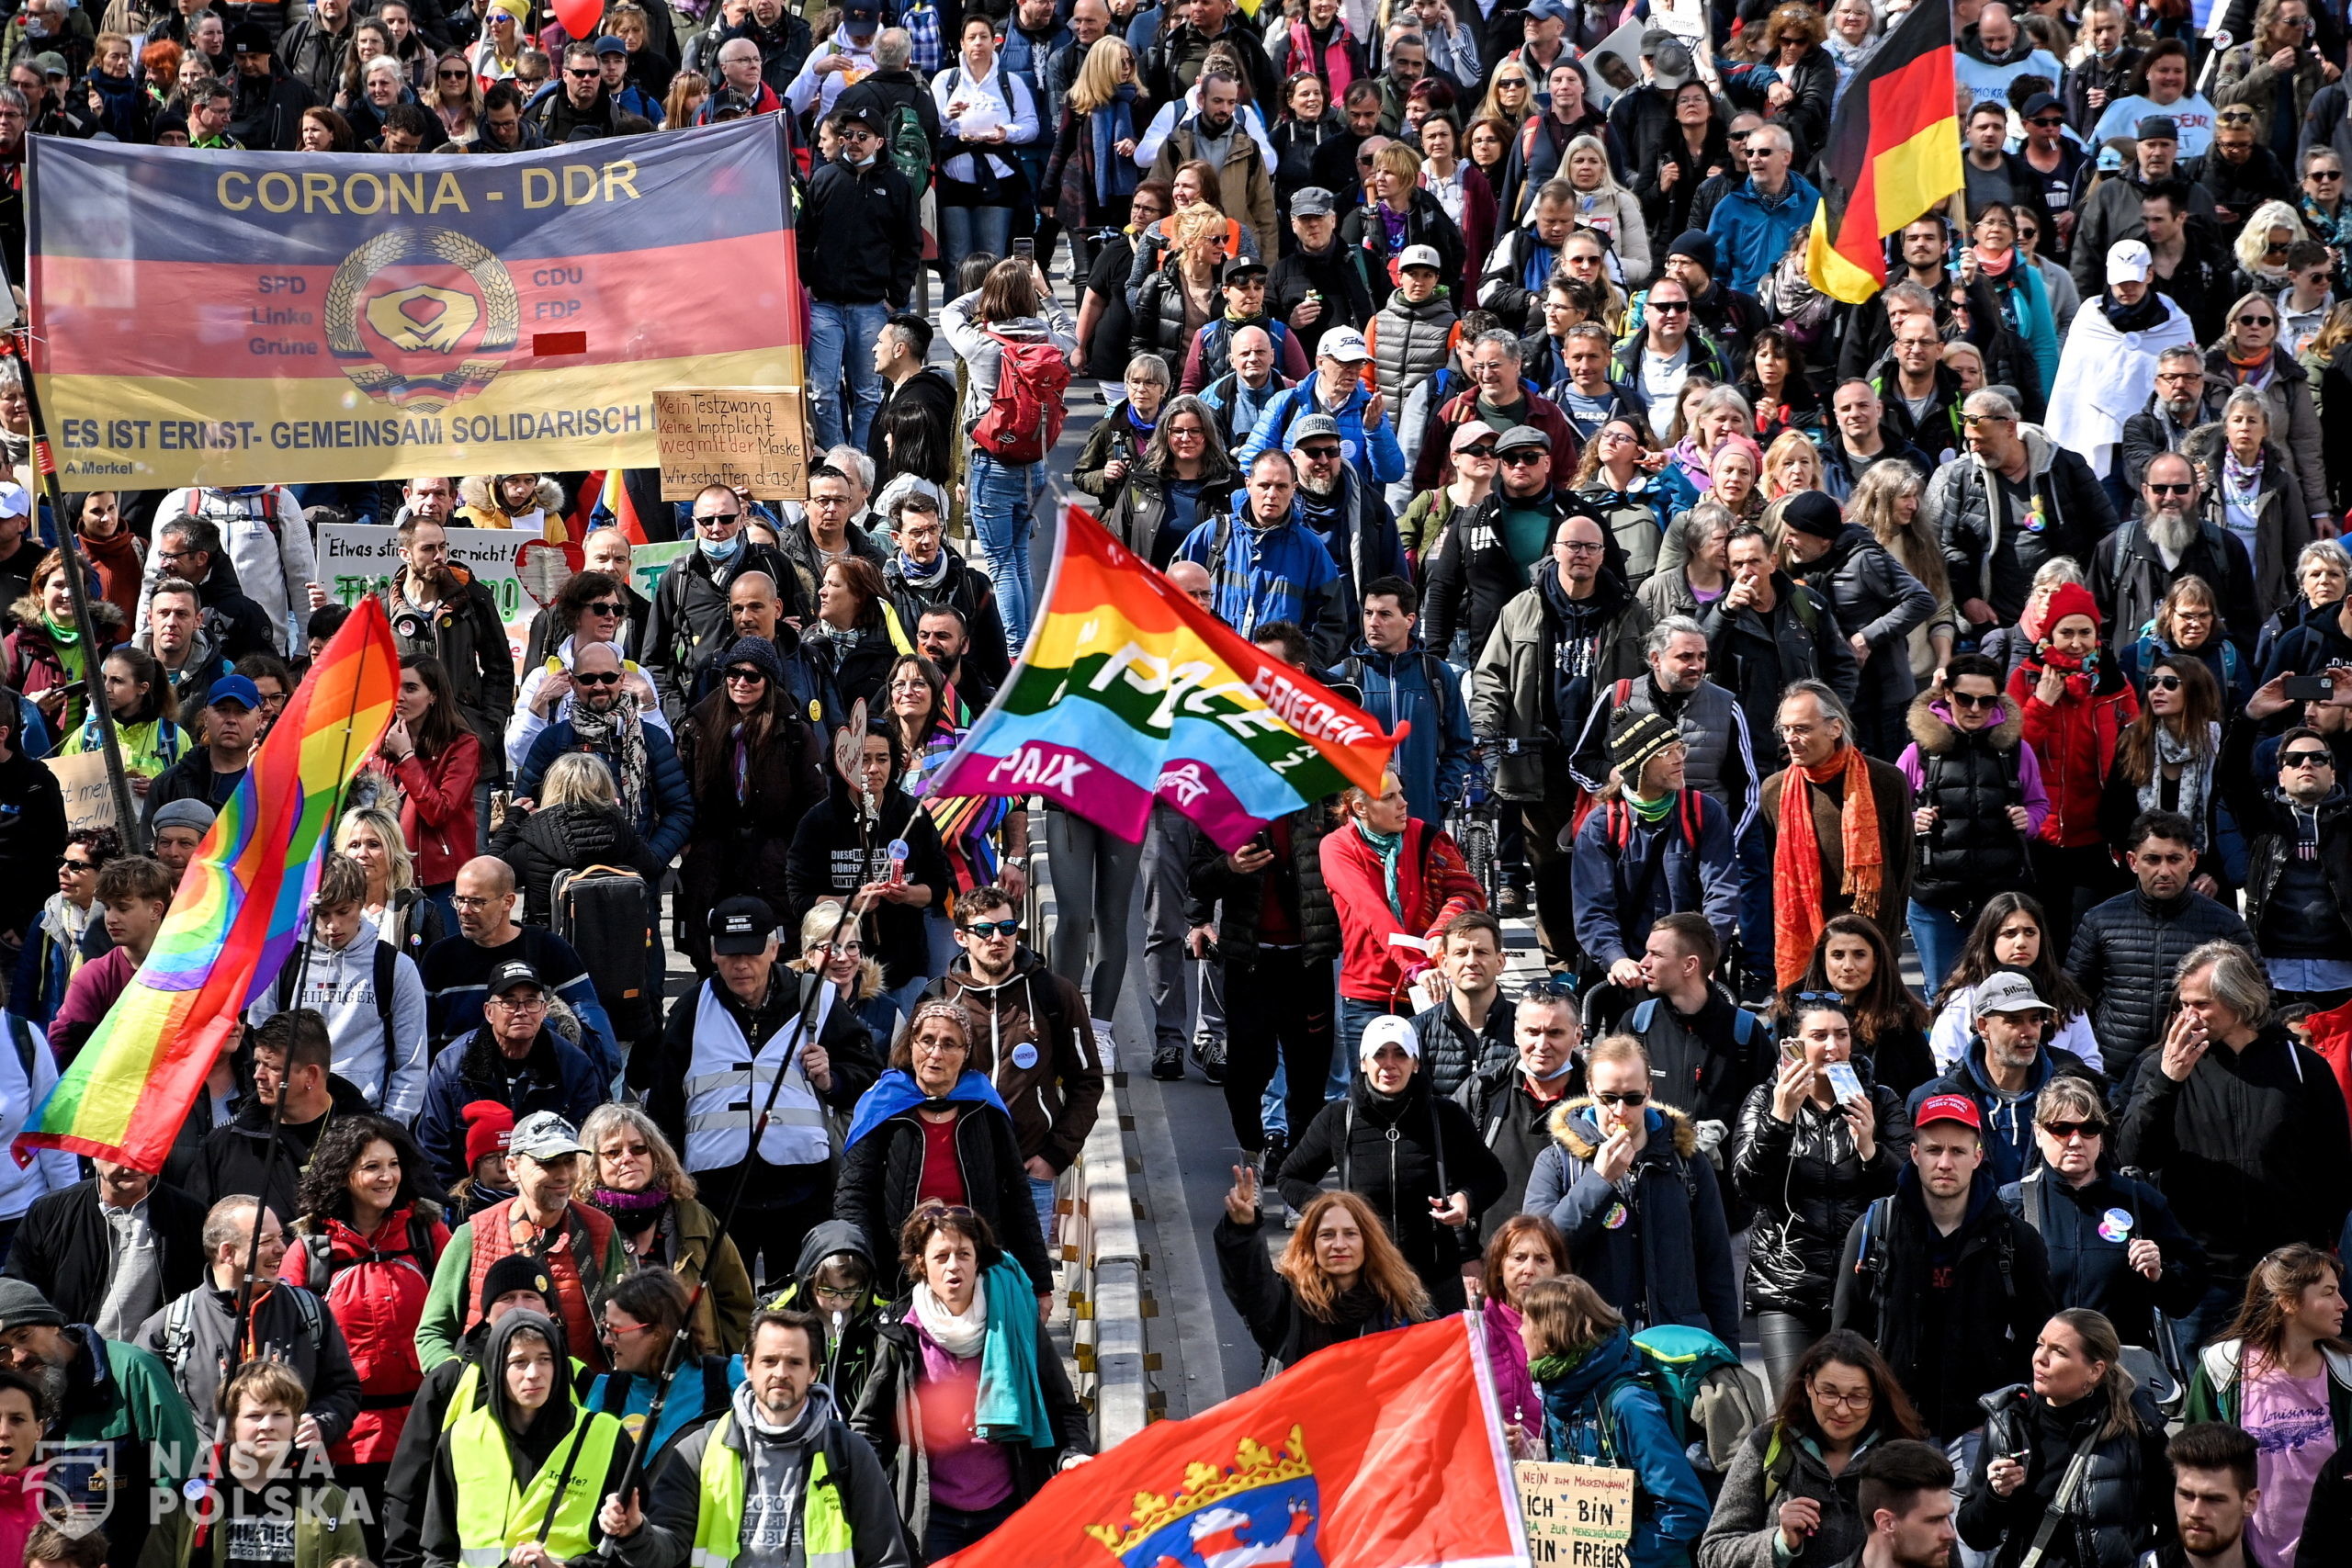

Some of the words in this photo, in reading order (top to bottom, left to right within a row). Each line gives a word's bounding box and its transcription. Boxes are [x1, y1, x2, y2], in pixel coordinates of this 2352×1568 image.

[217, 171, 470, 215] CORONA
[521, 159, 642, 209] DDR
[258, 275, 307, 294] SPD
[533, 267, 583, 288] CDU
[251, 307, 313, 326] Linke
[535, 299, 582, 320] FDP
[248, 337, 318, 355] Grüne
[658, 395, 691, 415] Kein
[690, 393, 772, 421] Testzwang
[62, 419, 99, 449] ES
[107, 420, 152, 449] IST
[159, 421, 262, 450] ERNST-
[270, 417, 444, 449] GEMEINSAM
[451, 404, 641, 444] SOLIDARISCH
[659, 419, 693, 434] Keine
[697, 415, 775, 442] Impfplicht
[698, 435, 726, 453] mit
[729, 435, 754, 453] der
[758, 436, 801, 457] Maske
[662, 464, 687, 484] Wir
[690, 463, 751, 486] schaffen
[1089, 641, 1280, 739] PACE
[988, 746, 1093, 798] PAIX
[831, 850, 854, 861] DIESE
[302, 991, 376, 1004] HILFIGER
[2261, 1406, 2325, 1424] Louisiana
[1522, 1472, 1548, 1484] NEIN
[327, 1517, 337, 1532] 9
[1550, 1523, 1568, 1536] ZUR
